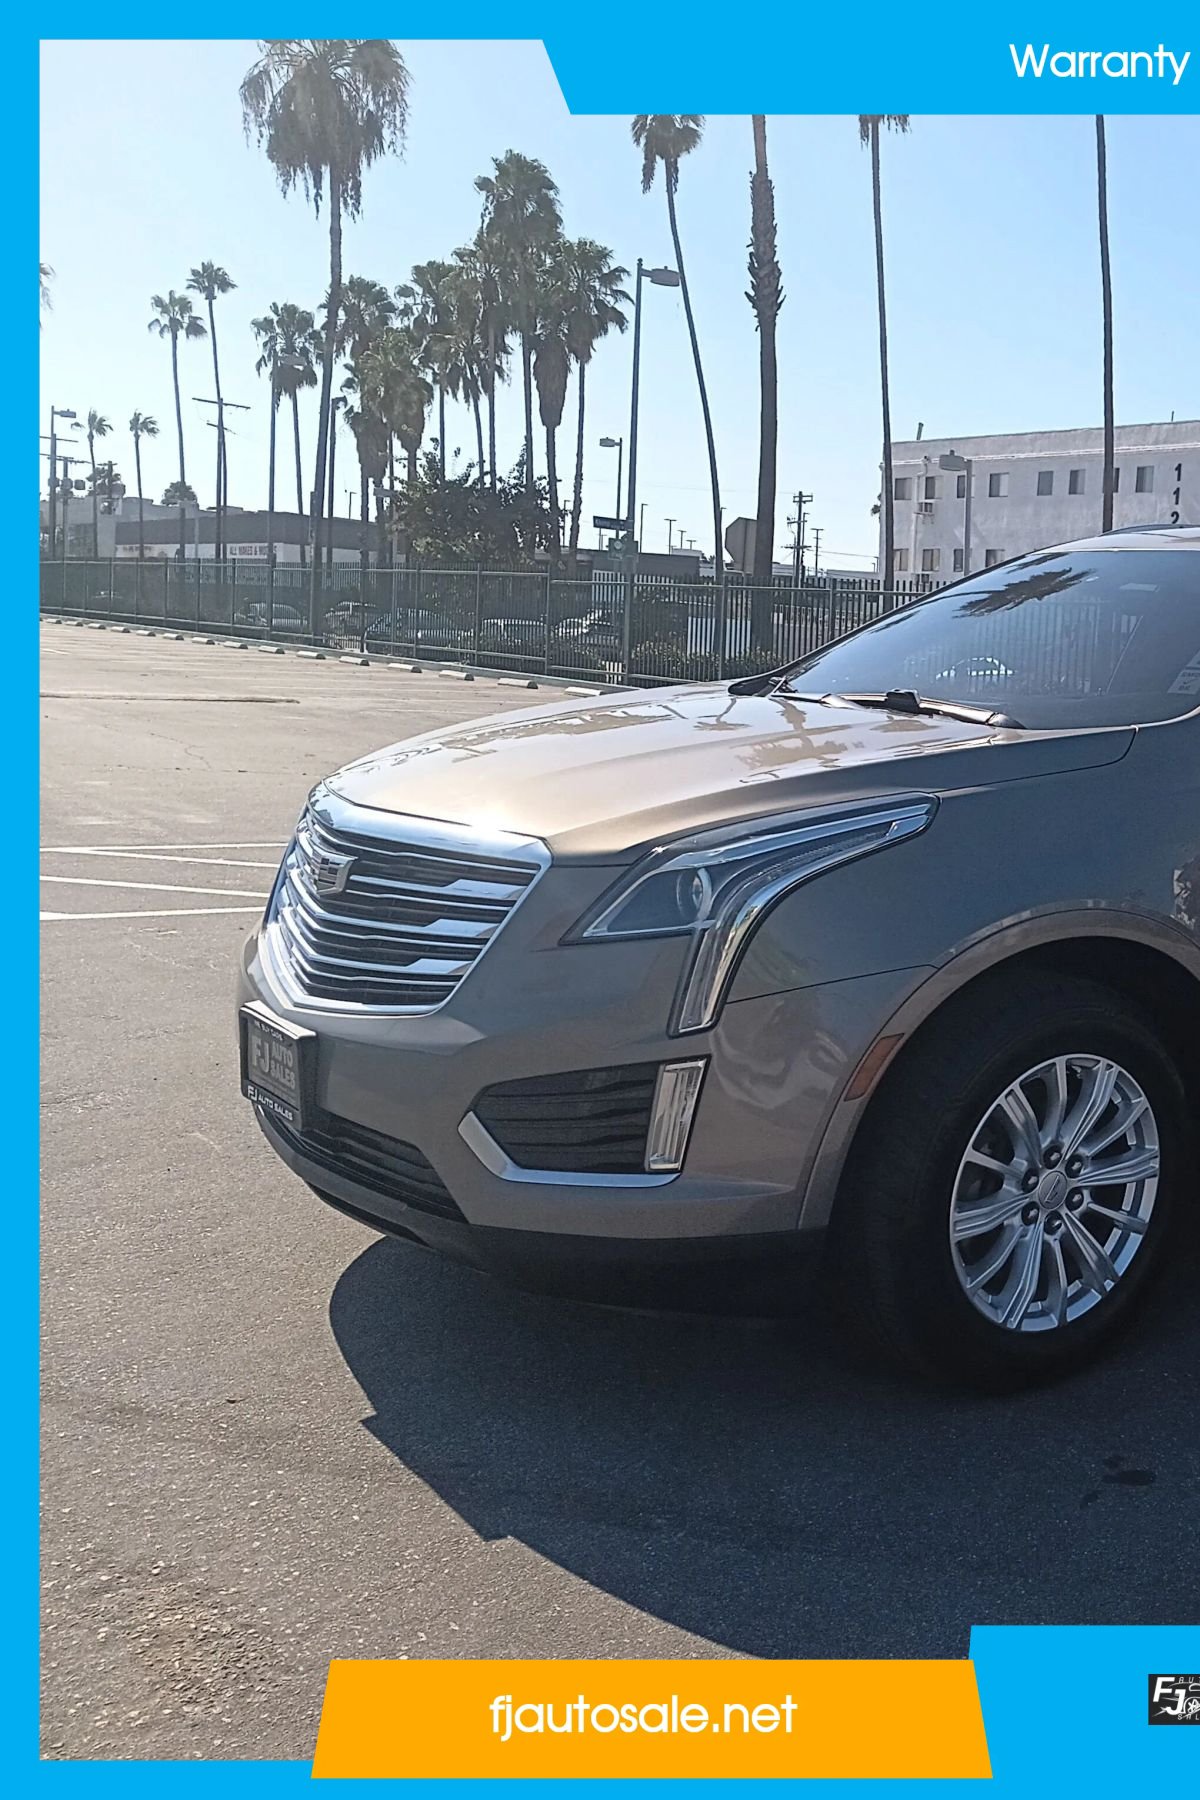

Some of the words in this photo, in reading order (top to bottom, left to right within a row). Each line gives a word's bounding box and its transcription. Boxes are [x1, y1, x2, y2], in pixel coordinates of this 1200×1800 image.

[251, 1034, 270, 1073] FJ
[271, 1041, 294, 1068] AUTO
[270, 1060, 296, 1090] SALES
[258, 1094, 274, 1109] AUTO
[274, 1103, 293, 1121] SALES
